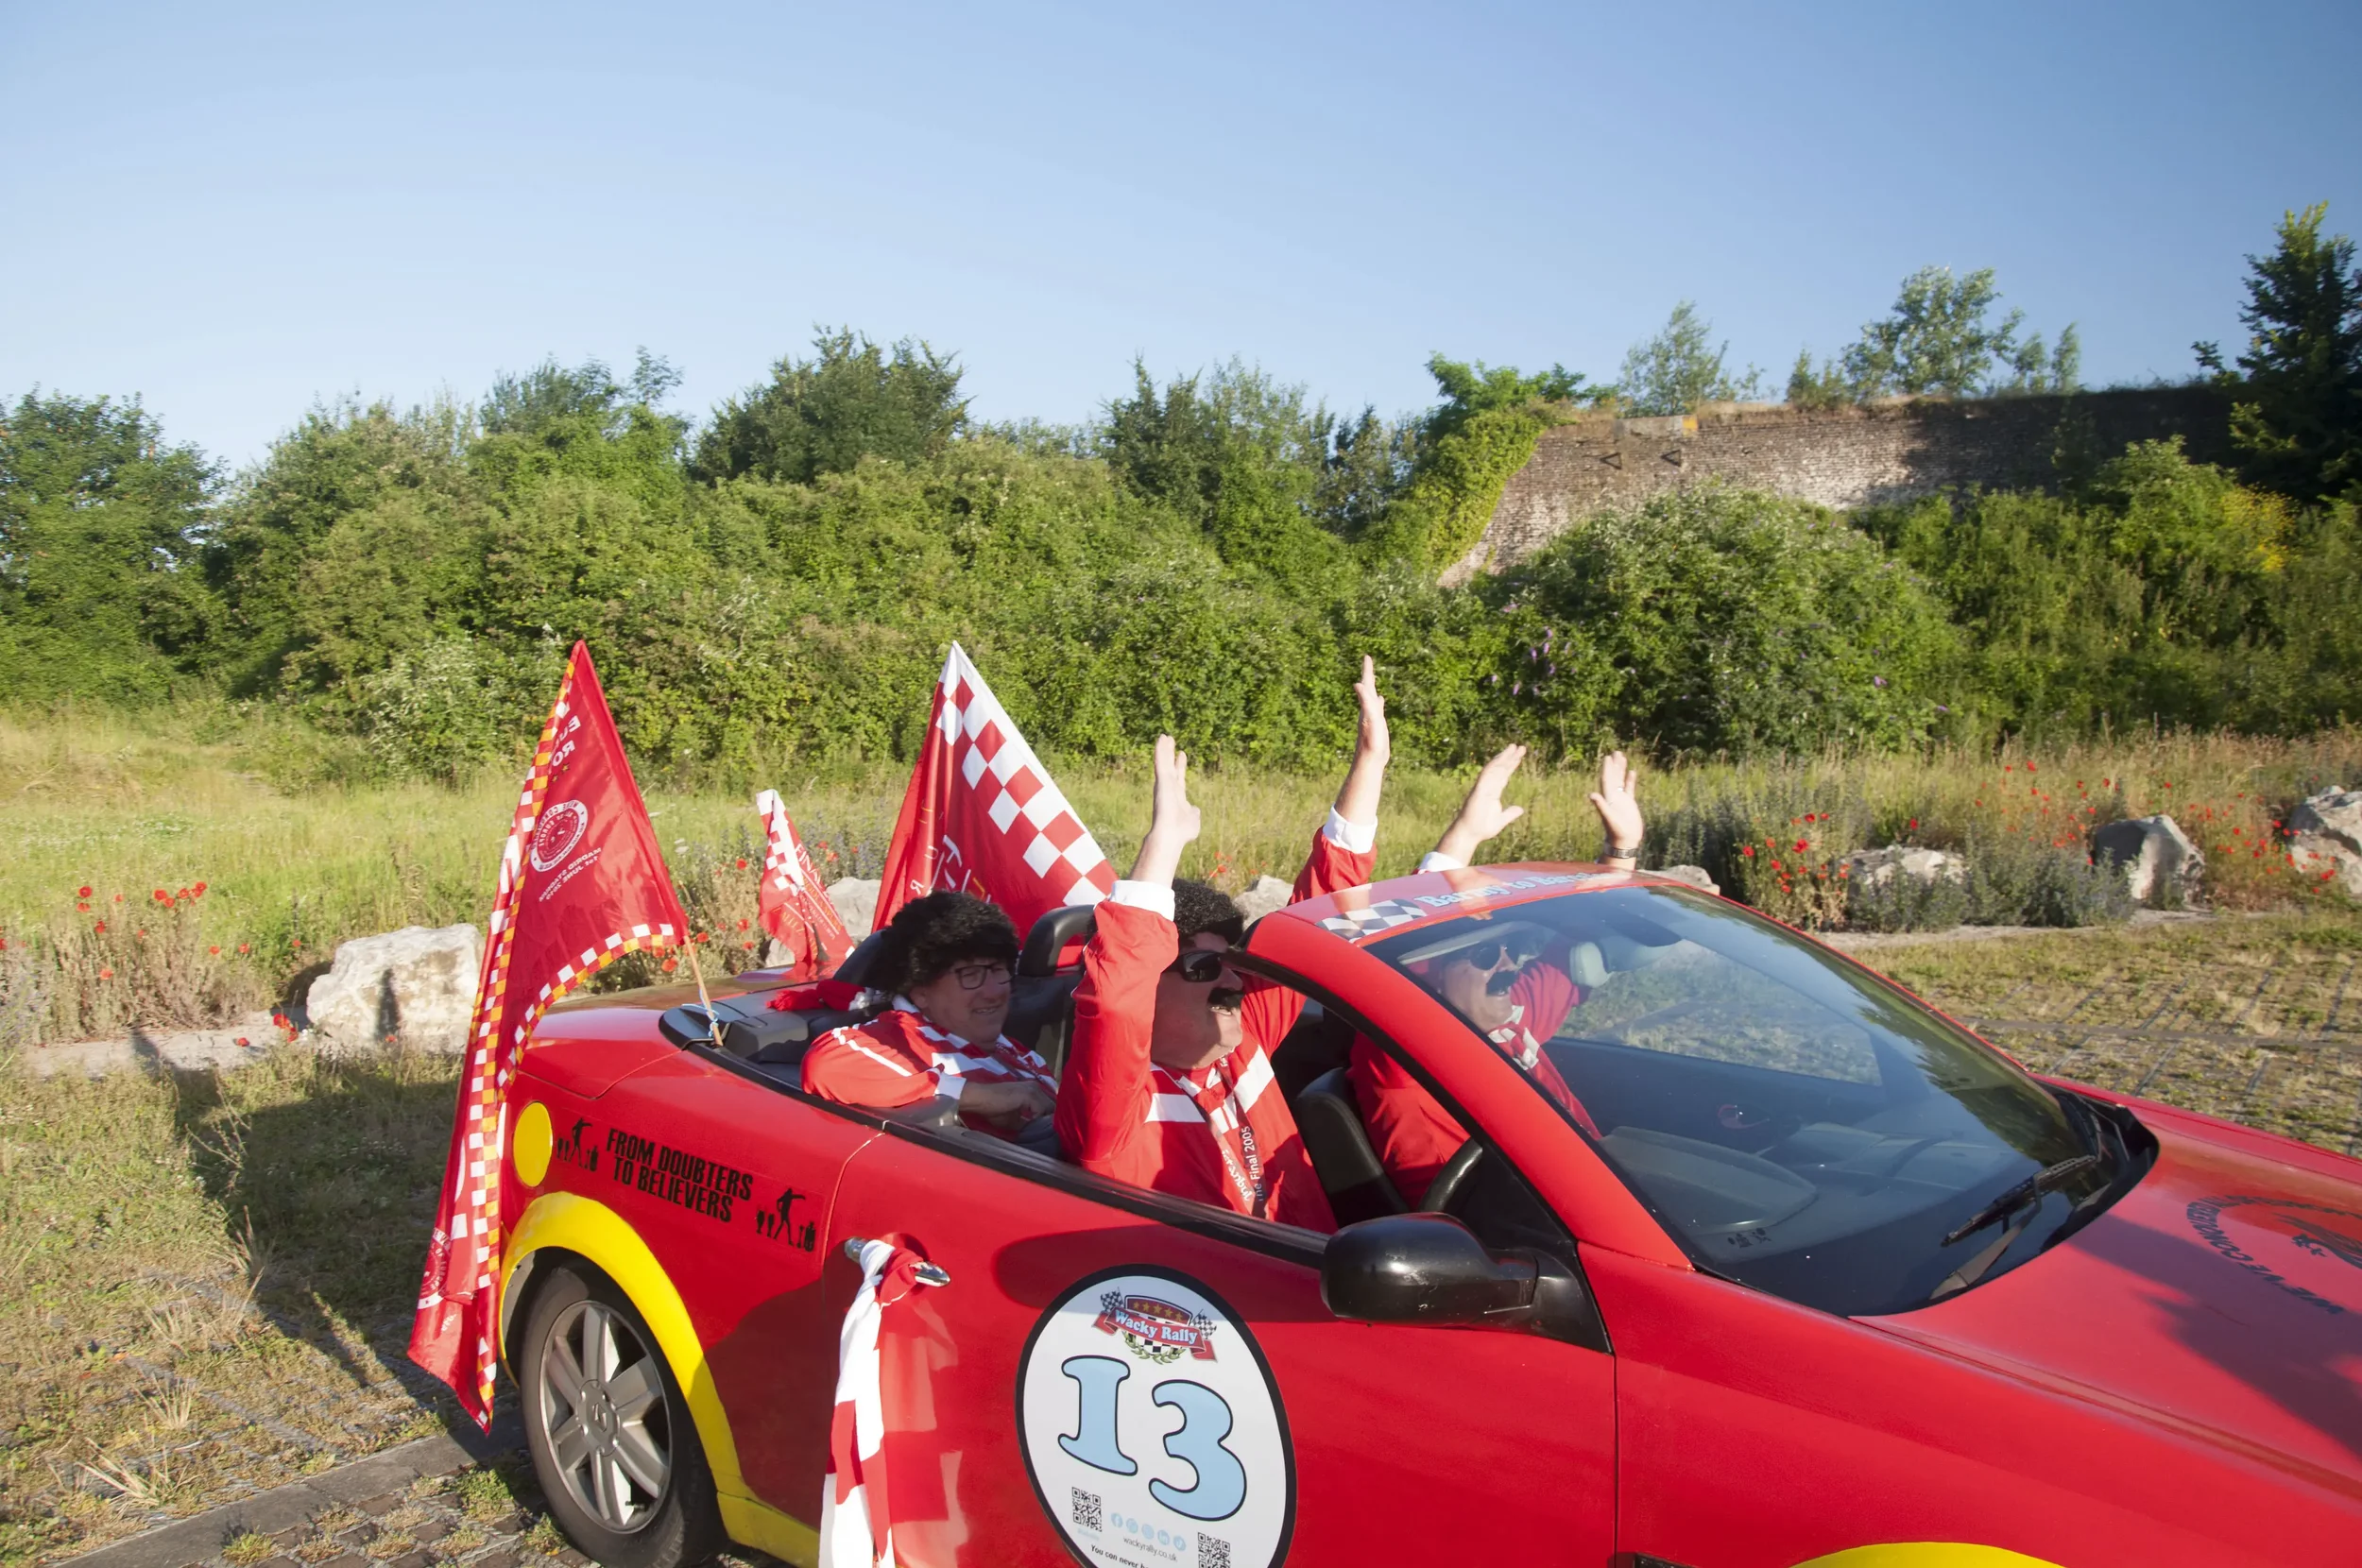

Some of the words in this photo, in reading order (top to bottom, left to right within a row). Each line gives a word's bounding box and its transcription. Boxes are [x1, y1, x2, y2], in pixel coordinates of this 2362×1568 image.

[1241, 1126, 1256, 1151] 2005
[606, 1128, 655, 1166] FROM
[658, 1145, 754, 1201] DOUBTERS
[1245, 1153, 1259, 1180] Final
[613, 1156, 634, 1185] TO
[637, 1165, 733, 1222] BELIEVERS
[1115, 1309, 1157, 1338] Wacky
[1161, 1326, 1198, 1344] Rally
[1058, 1355, 1247, 1522] 13
[1091, 1544, 1104, 1555] You
[1105, 1551, 1118, 1560] can
[1119, 1557, 1139, 1568] never
